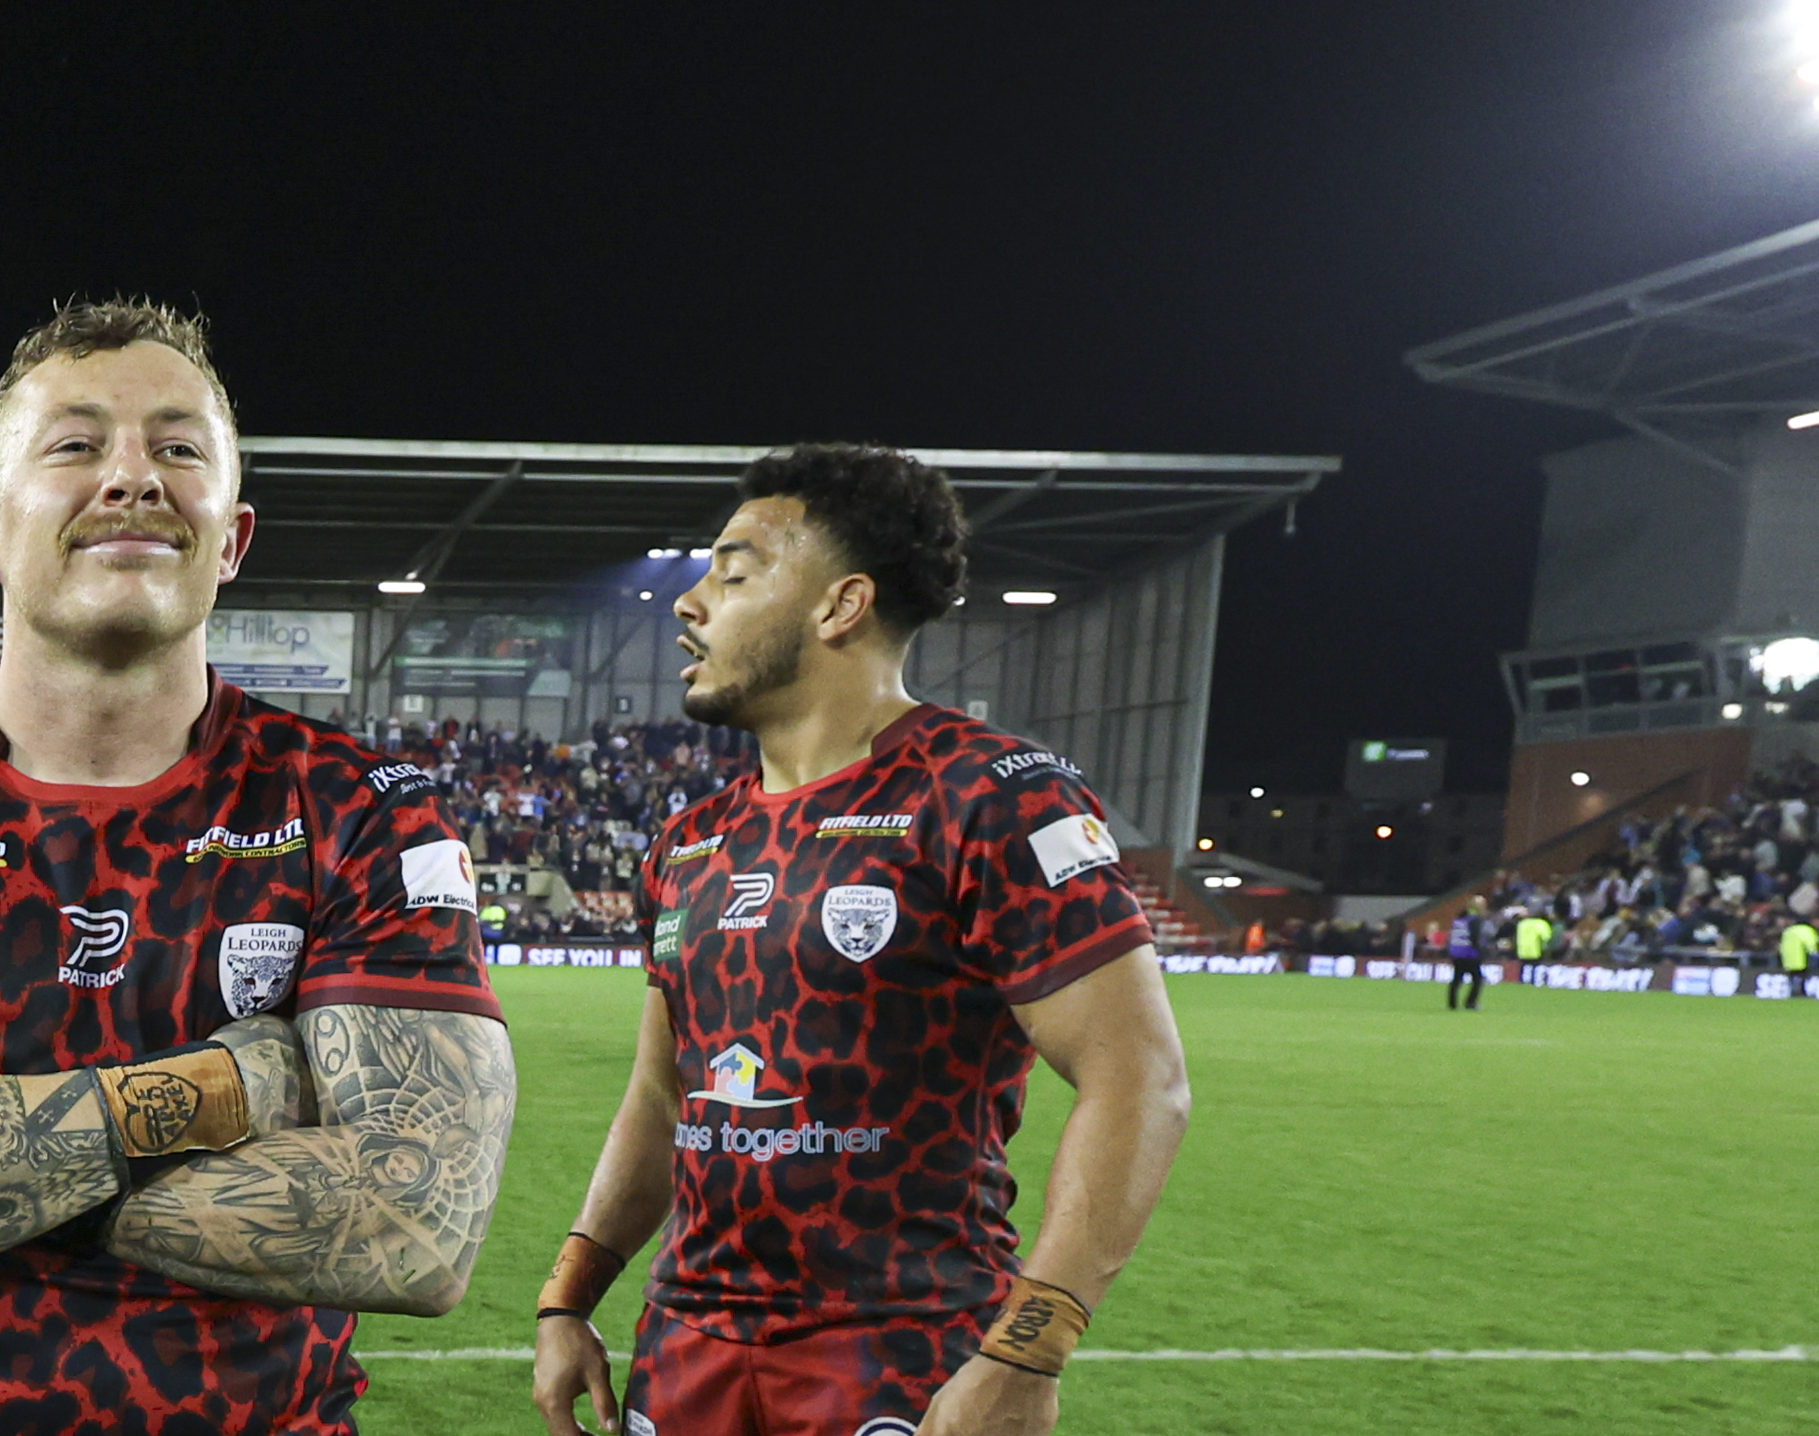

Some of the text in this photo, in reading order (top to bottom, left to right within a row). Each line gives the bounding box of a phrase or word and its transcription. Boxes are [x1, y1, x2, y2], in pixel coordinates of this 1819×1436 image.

[881, 814, 913, 828] LTD
[186, 826, 270, 853] FITFIELD
[828, 895, 892, 907] LEOPARDS
[717, 915, 768, 931] PATRICK
[251, 928, 286, 937] LEIGH
[227, 937, 302, 953] LEOPARDS
[619, 949, 642, 967] IN
[58, 963, 125, 988] PATRICK
[720, 1120, 890, 1162] together
